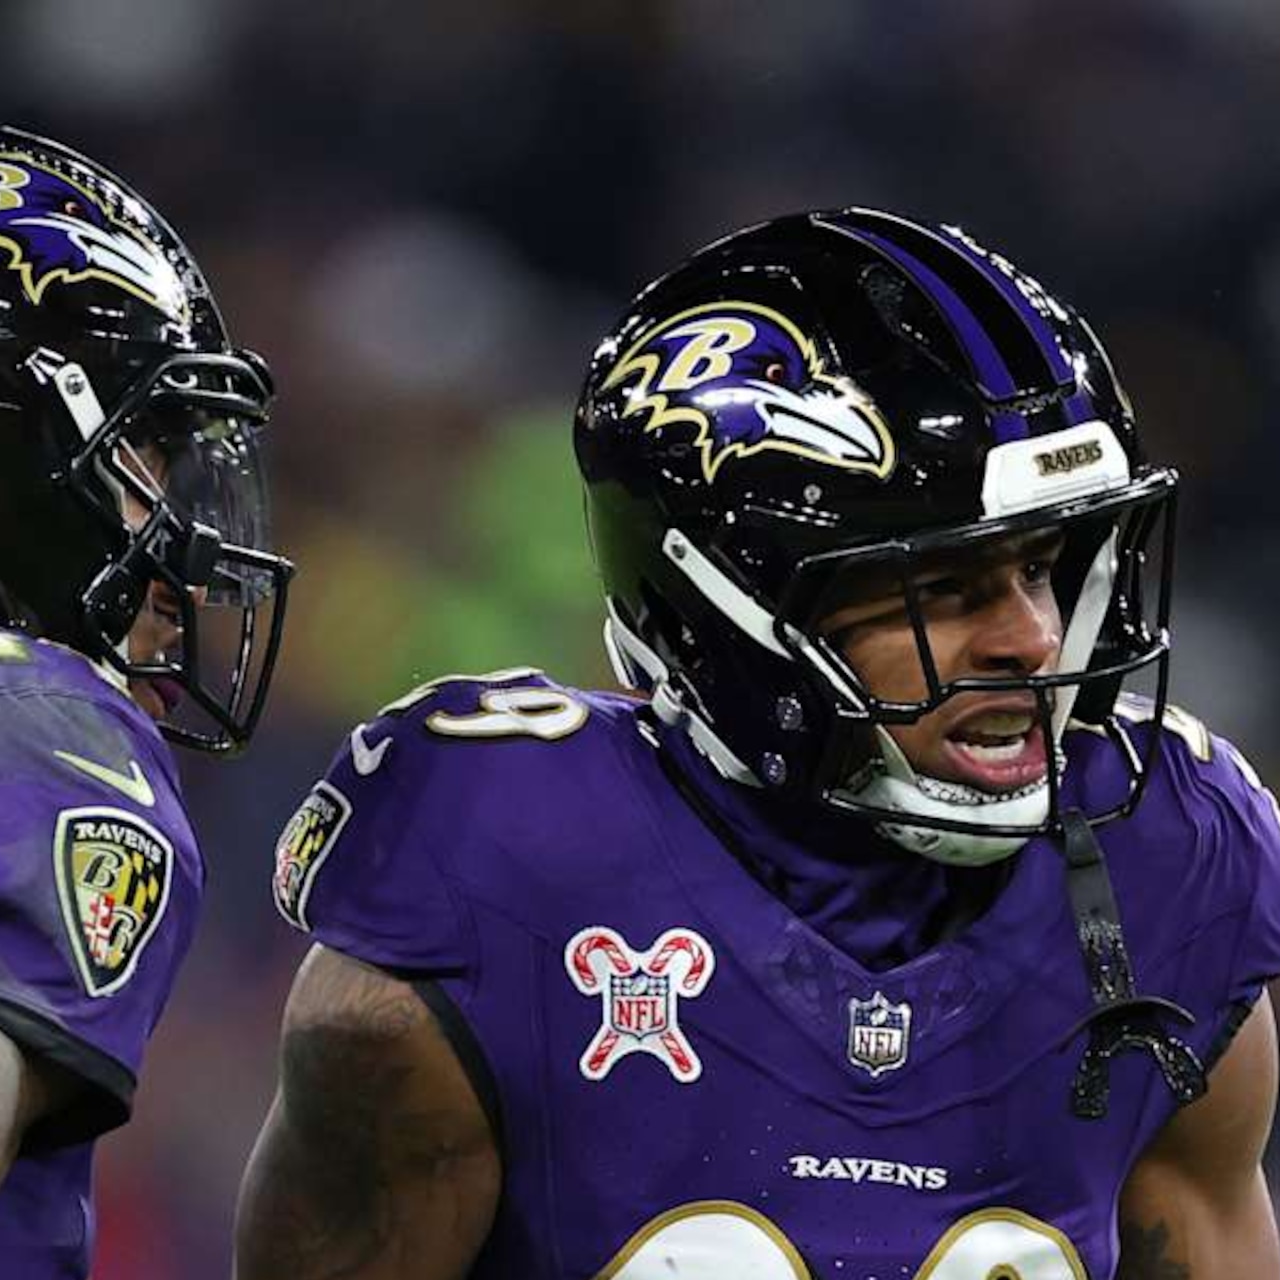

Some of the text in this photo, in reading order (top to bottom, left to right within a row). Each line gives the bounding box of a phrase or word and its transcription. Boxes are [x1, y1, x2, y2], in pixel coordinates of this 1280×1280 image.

[658, 317, 756, 391] B
[1034, 440, 1103, 476] RAVENS
[74, 821, 163, 864] RAVENS
[613, 995, 664, 1032] NFL
[858, 1028, 900, 1061] NFL
[788, 1154, 948, 1190] RAVENS
